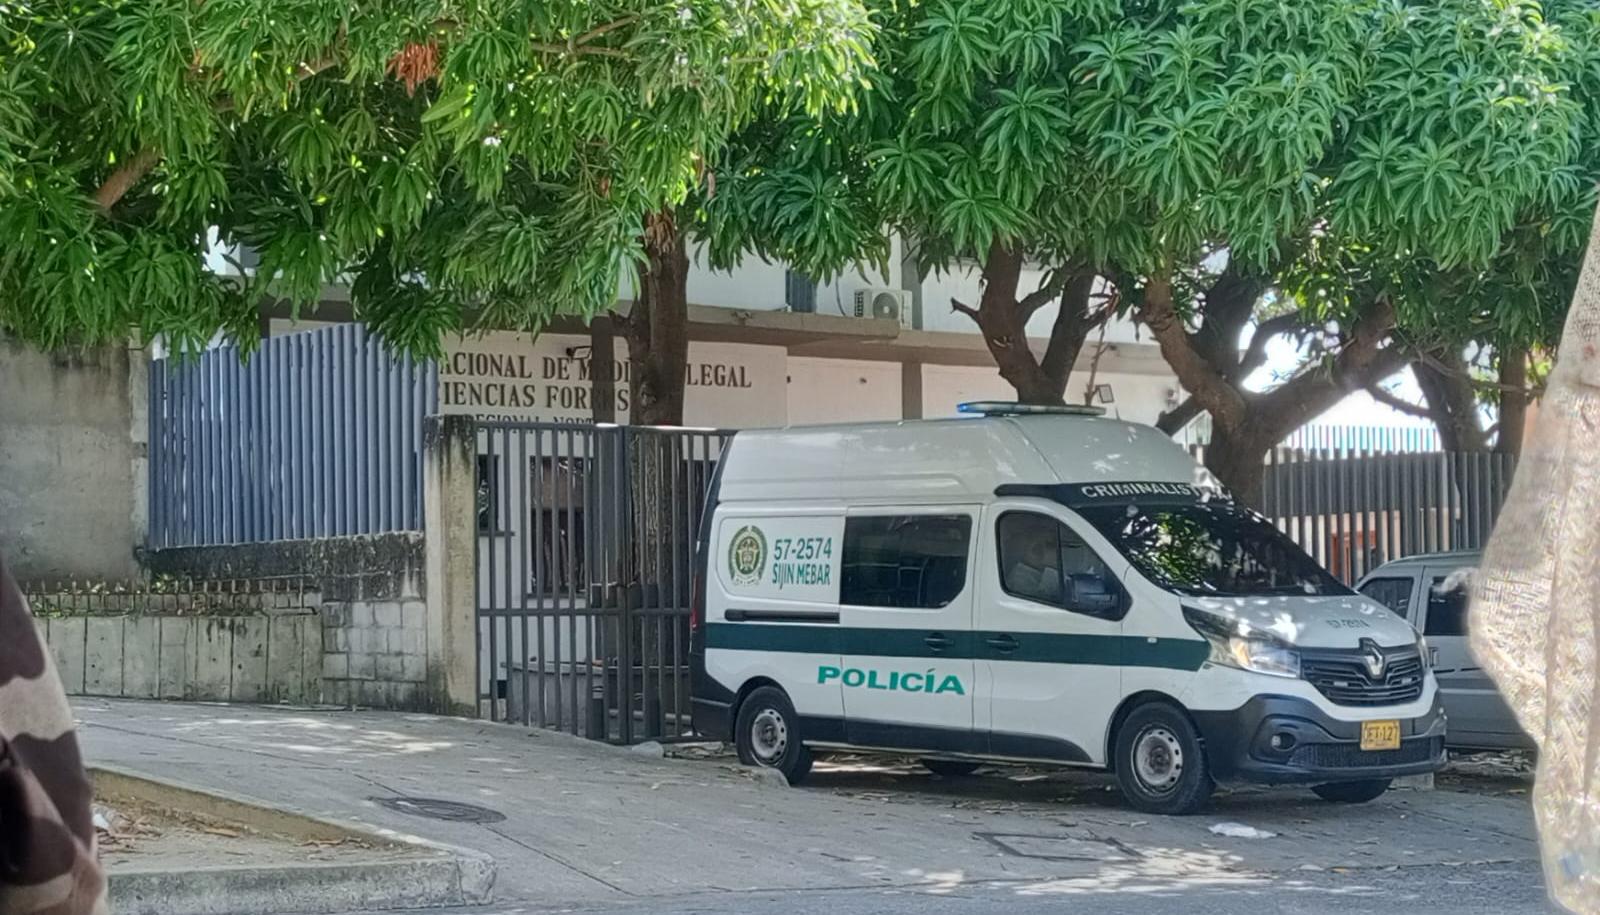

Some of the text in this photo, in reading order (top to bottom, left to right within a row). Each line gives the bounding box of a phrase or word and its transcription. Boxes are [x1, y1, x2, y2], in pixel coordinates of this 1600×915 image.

[440, 352, 533, 379] ACIONAL
[543, 357, 570, 381] DE
[686, 363, 752, 388] LEGAL
[438, 381, 535, 408] IENCIAS
[1081, 482, 1212, 499] CRIMINALIST
[774, 537, 832, 560] 57-2574
[772, 563, 795, 589] SIJIN
[797, 564, 831, 586] MEBAR
[817, 666, 966, 695] POLICÍA
